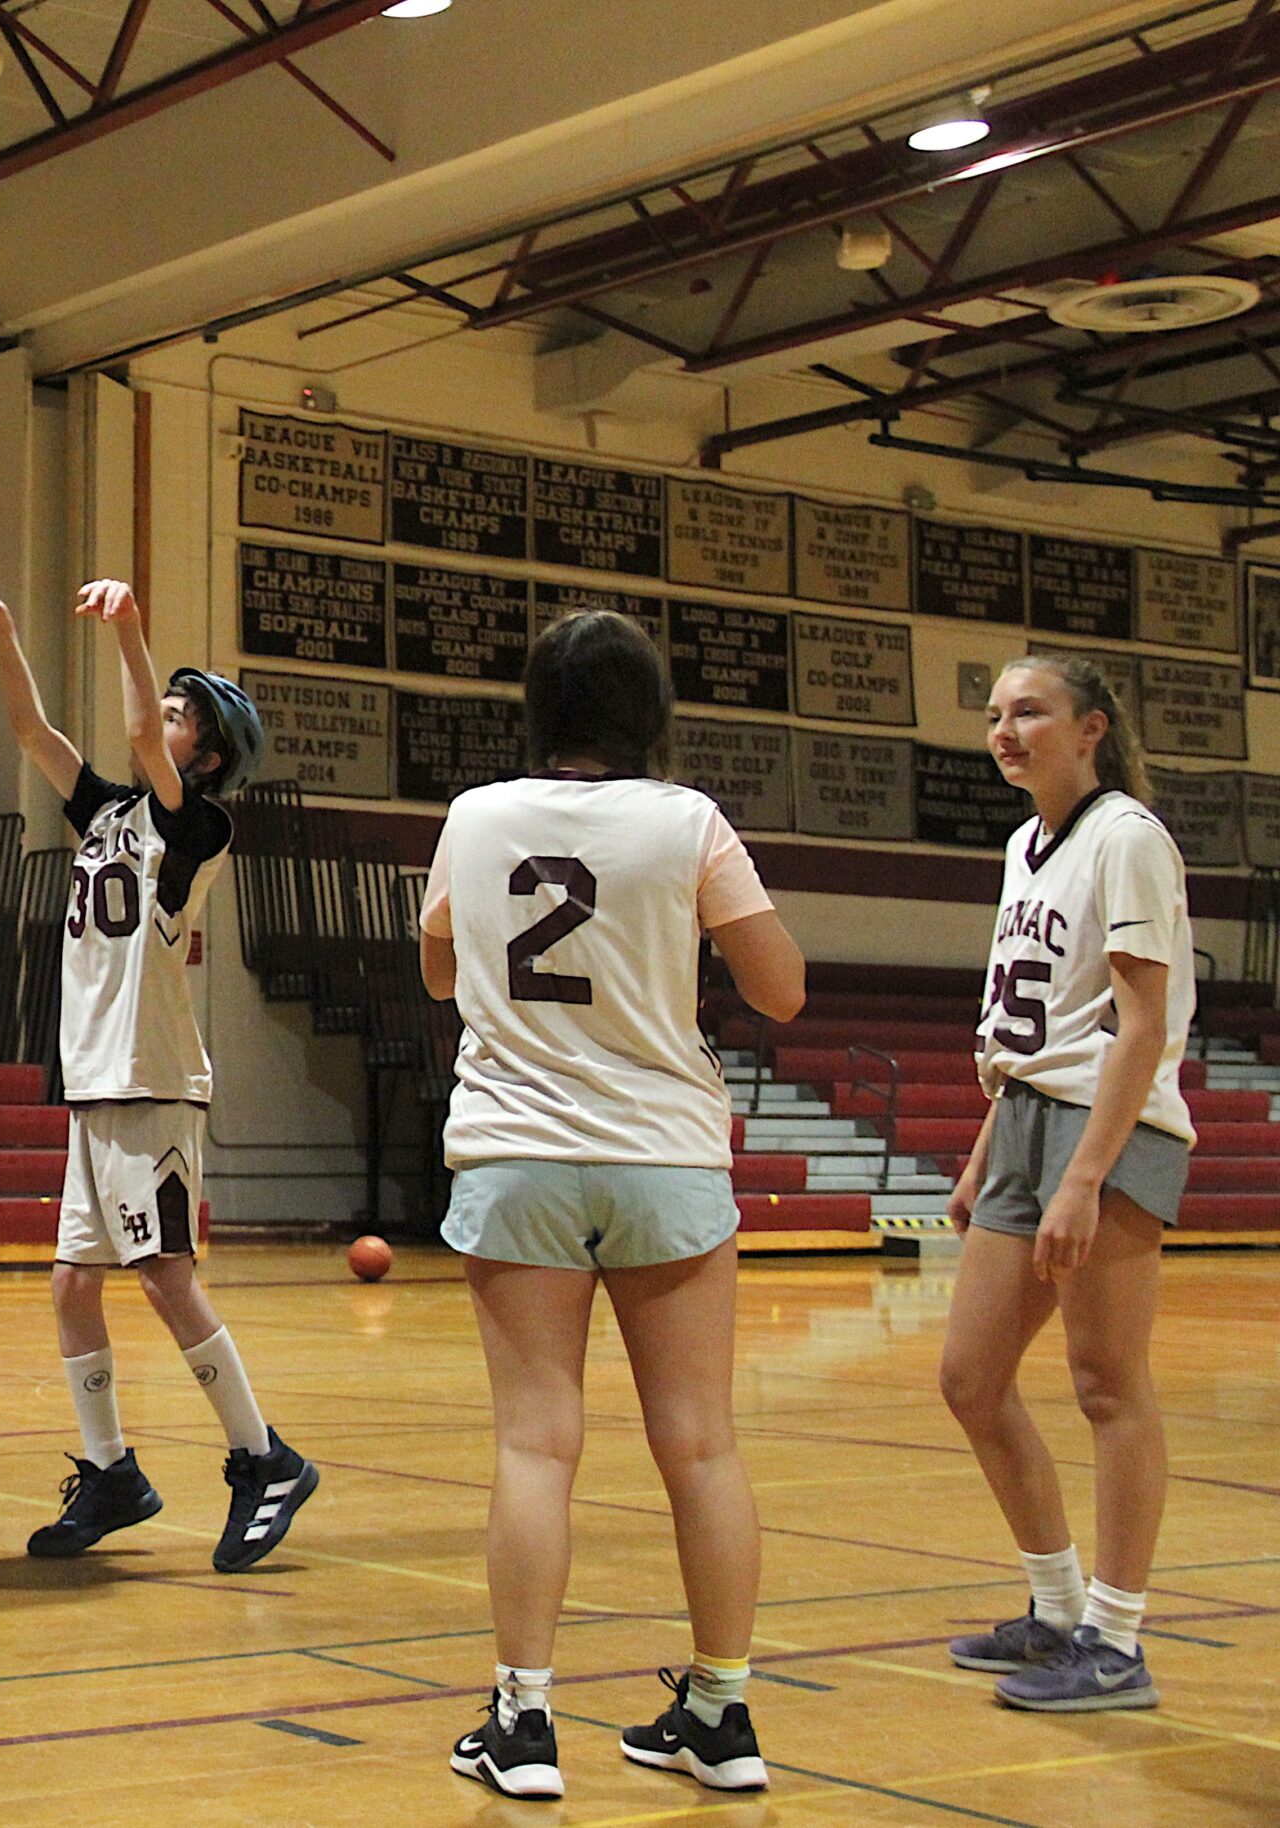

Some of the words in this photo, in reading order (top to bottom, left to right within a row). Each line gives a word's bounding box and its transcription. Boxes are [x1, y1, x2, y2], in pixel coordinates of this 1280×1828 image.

[248, 422, 335, 452] LEAGUE
[350, 438, 379, 459] VII
[244, 446, 383, 485] BASKETBALL
[539, 462, 616, 490] LEAGUE
[392, 480, 526, 517] BASKETBALL
[420, 506, 500, 534] CHAMPS
[533, 502, 661, 535] BASKETBALL
[560, 526, 636, 553] CHAMPS
[253, 569, 374, 602] CHAMPIONS
[418, 570, 481, 591] LEAGUE
[243, 589, 284, 612] STATE
[259, 612, 368, 642] SOFTBALL
[428, 605, 480, 626] CLASS
[800, 624, 866, 646] LEAGUE
[295, 637, 334, 660] 2001
[431, 639, 495, 661] CHAMPS
[830, 649, 873, 669] GOLF
[256, 683, 350, 708] DIVISION
[361, 694, 376, 712] II
[418, 699, 482, 717] LEAGUE
[294, 711, 382, 737] VOLLEYBALL
[274, 735, 358, 760] CHAMPS
[297, 762, 335, 783] 2014
[507, 855, 597, 1005] 2
